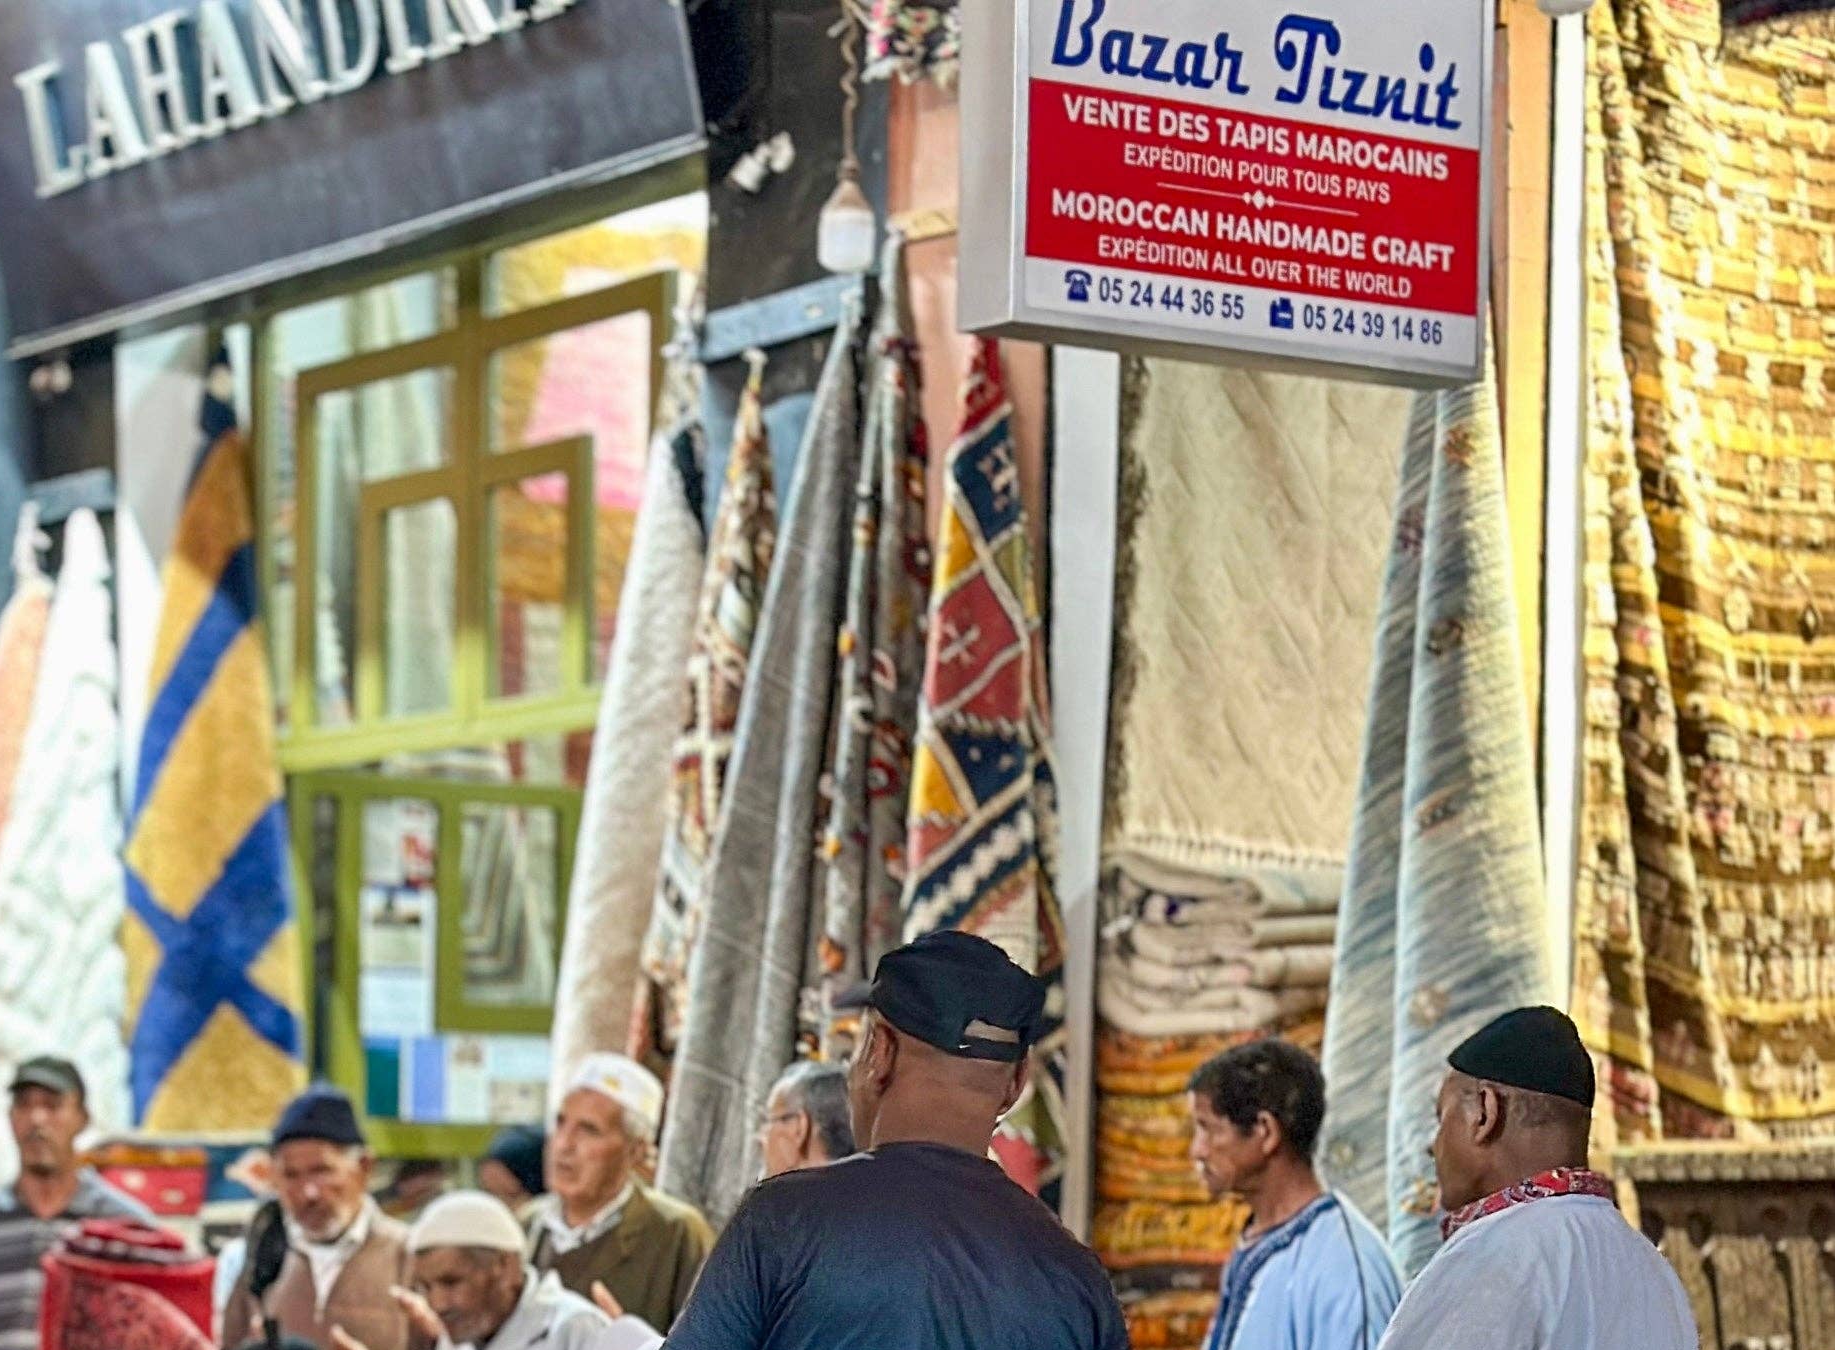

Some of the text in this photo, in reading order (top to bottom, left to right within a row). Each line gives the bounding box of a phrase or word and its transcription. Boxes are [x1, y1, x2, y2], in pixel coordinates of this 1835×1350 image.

[13, 0, 580, 198] LAHANDI
[1051, 0, 1462, 130] Bazar Tiznit
[1063, 93, 1449, 180] VENTE DES TAPIS MAROCAINS
[1124, 142, 1391, 204] EXPÉDITION POUR TOUS PAYS
[1051, 188, 1454, 271] MOROCCAN HANDMADE CRAFT
[1098, 234, 1411, 299] EXPÉDITION ALL OVER THE WORLD
[1099, 276, 1244, 320] 05 24 44 36 55
[1303, 303, 1442, 345] 05 24 39 14 86
